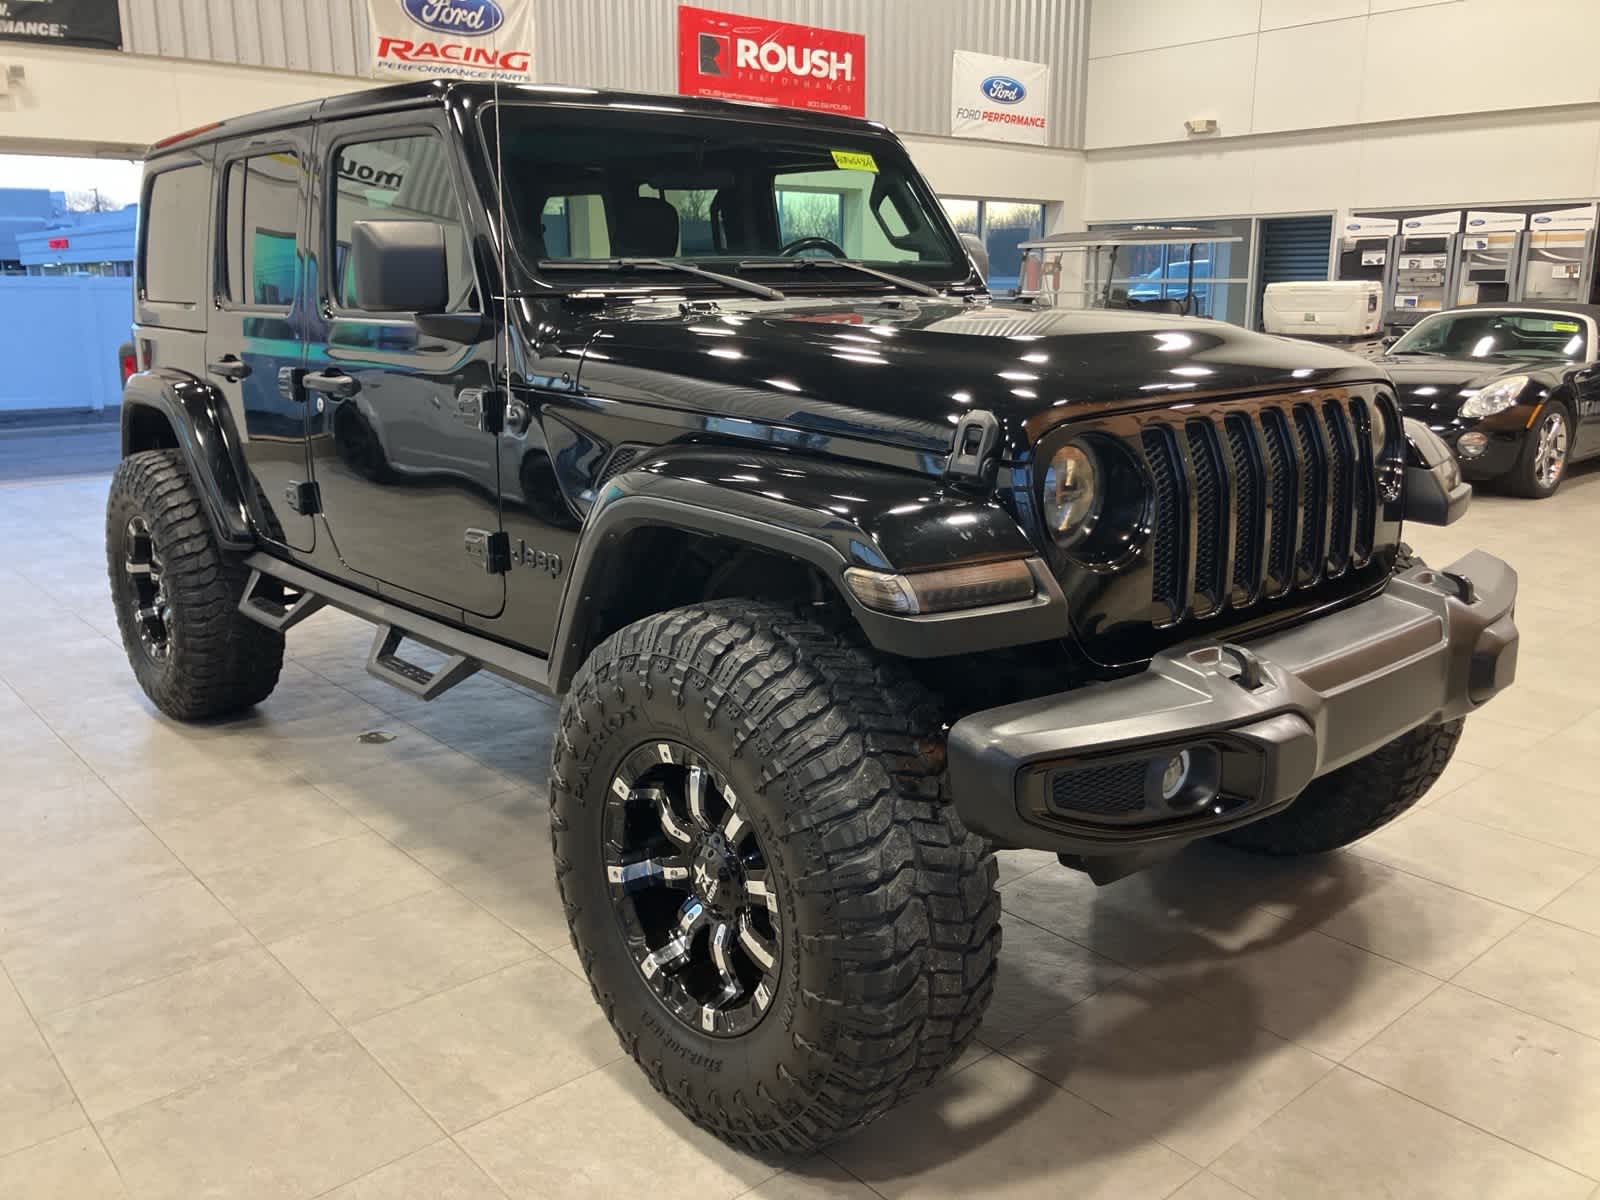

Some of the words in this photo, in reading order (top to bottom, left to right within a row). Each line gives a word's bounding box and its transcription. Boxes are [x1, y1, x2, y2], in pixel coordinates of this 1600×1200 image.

[421, 0, 484, 29] Ford
[377, 37, 531, 72] RACING
[736, 38, 853, 81] ROUSH
[377, 61, 489, 79] PERFORMANCE
[737, 71, 853, 92] PERFORMANCE
[989, 79, 1018, 100] Ford
[956, 107, 981, 120] FORD
[981, 111, 1046, 128] PERFORMANCE
[511, 538, 562, 579] Jeep
